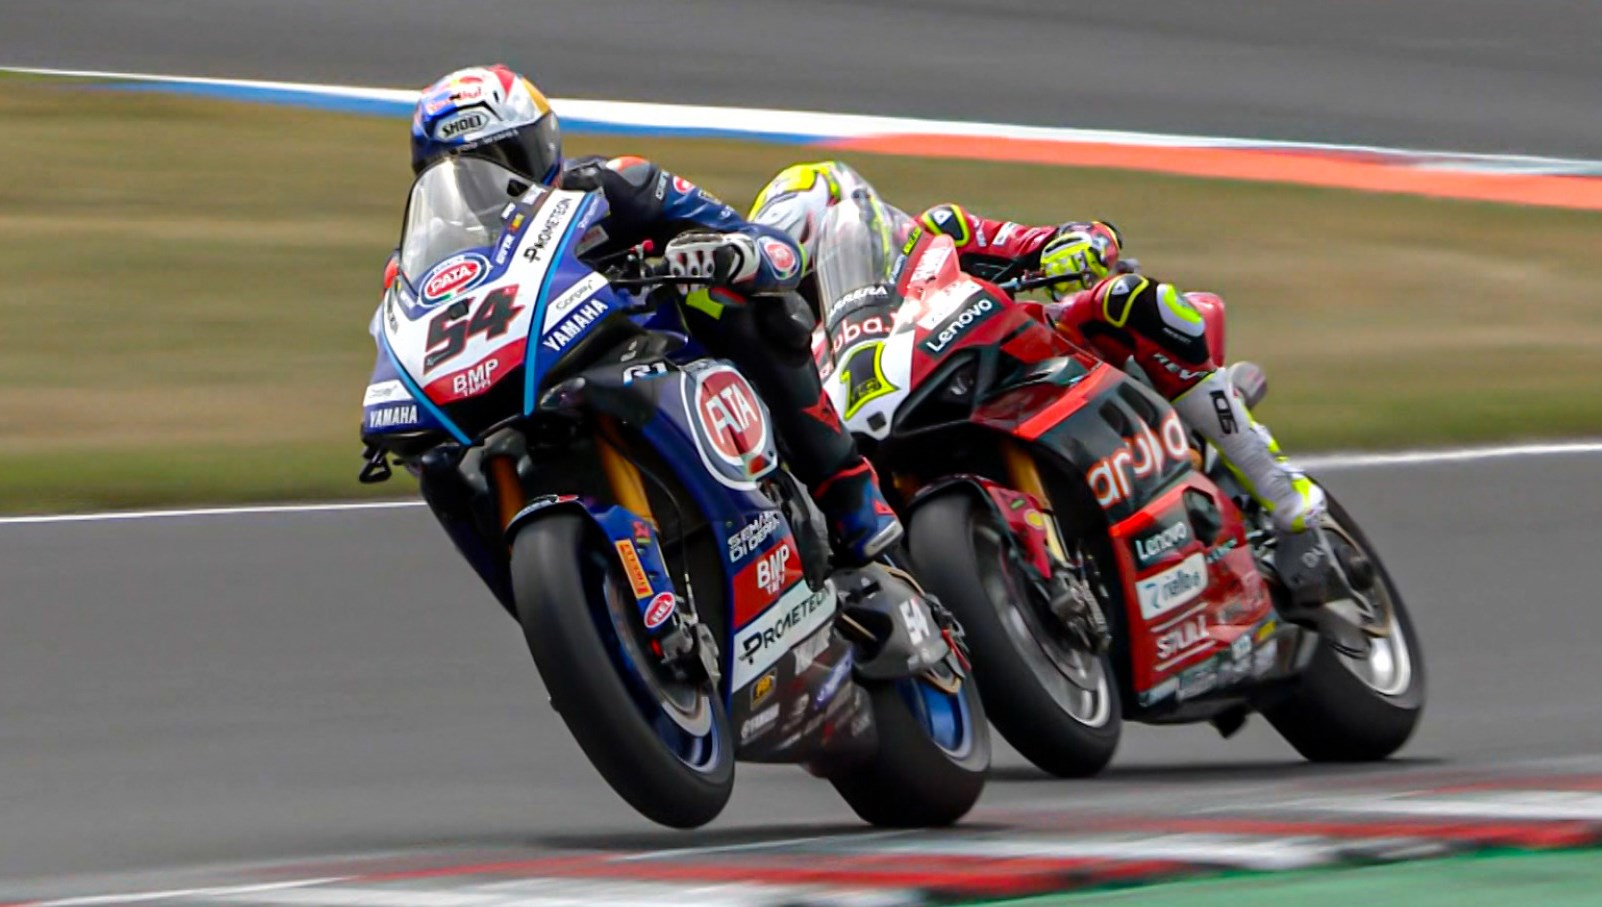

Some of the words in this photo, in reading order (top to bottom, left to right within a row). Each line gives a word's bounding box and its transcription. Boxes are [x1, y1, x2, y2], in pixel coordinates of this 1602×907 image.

[441, 115, 483, 137] SHOEI
[430, 266, 474, 293] PATA
[422, 284, 526, 376] 54
[542, 298, 609, 352] YAMAHA
[926, 299, 993, 353] Lenovo
[453, 359, 499, 394] BMP
[840, 341, 900, 421] 1
[369, 405, 418, 428] YAMAHA
[1135, 521, 1187, 560] Lenovo
[757, 544, 790, 589] BMP
[739, 588, 831, 664] PROMETEO
